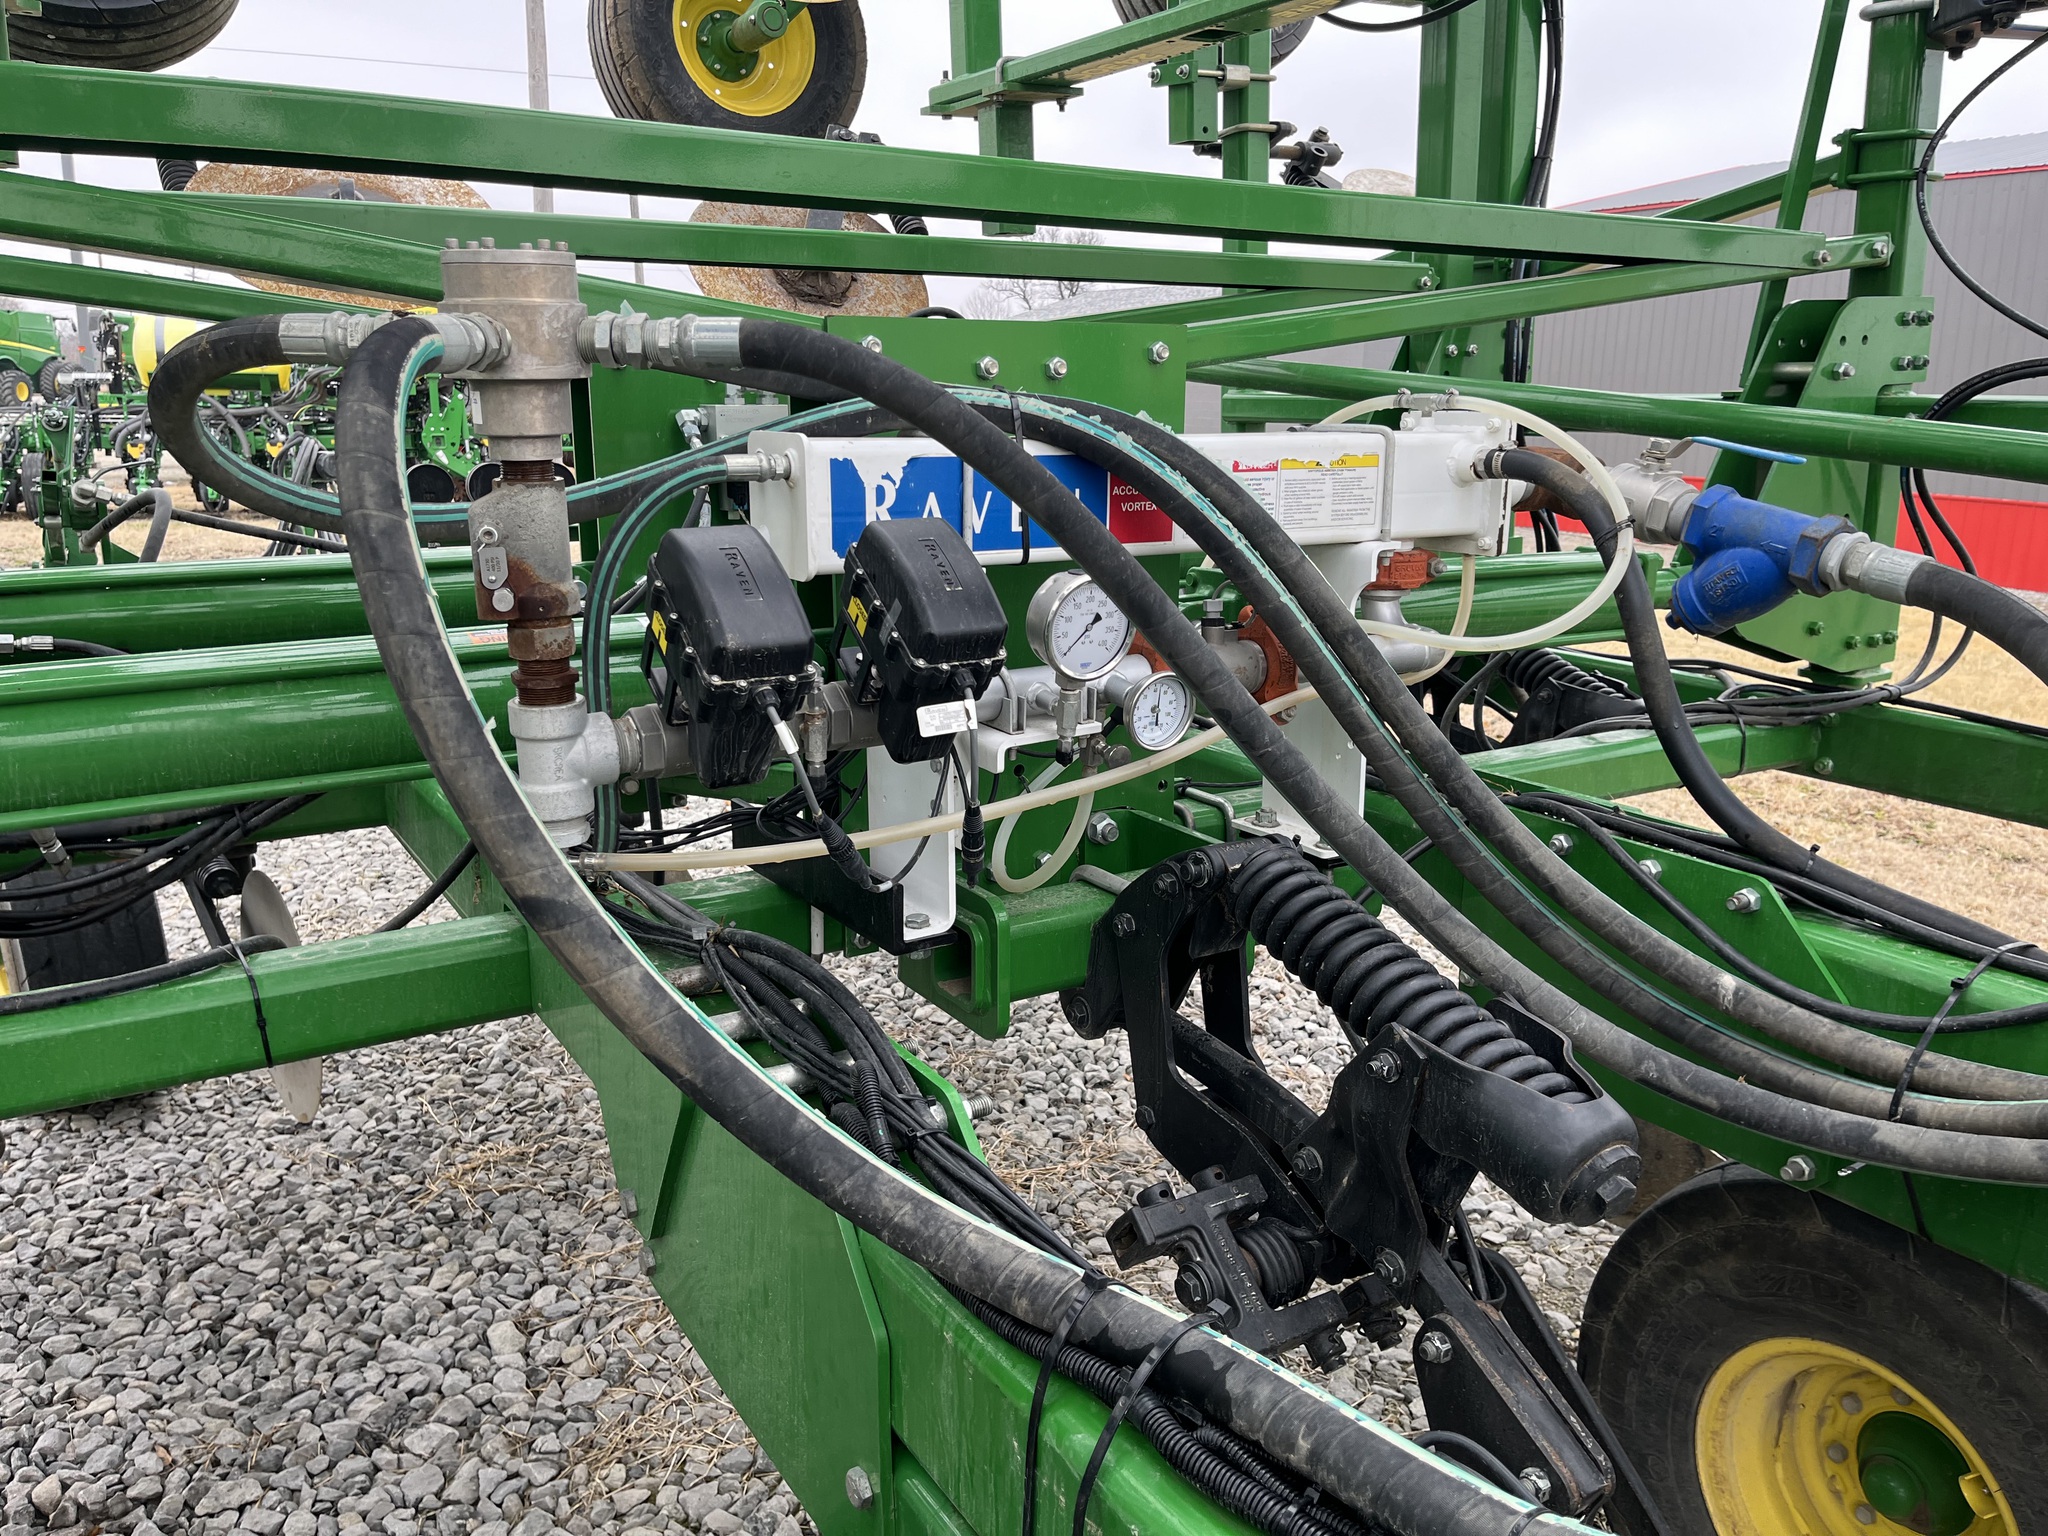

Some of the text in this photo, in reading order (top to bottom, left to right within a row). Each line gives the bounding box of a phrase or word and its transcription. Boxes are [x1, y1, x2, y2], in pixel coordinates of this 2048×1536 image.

[1112, 485, 1139, 495] ACCU
[1121, 501, 1158, 512] VORTEX
[924, 544, 954, 585] RAVEN
[725, 553, 754, 595] RAVEN
[1086, 595, 1095, 603] 200
[1073, 602, 1082, 610] 150
[1097, 600, 1107, 608] 250
[1105, 611, 1114, 619] 300
[1061, 631, 1068, 639] 50
